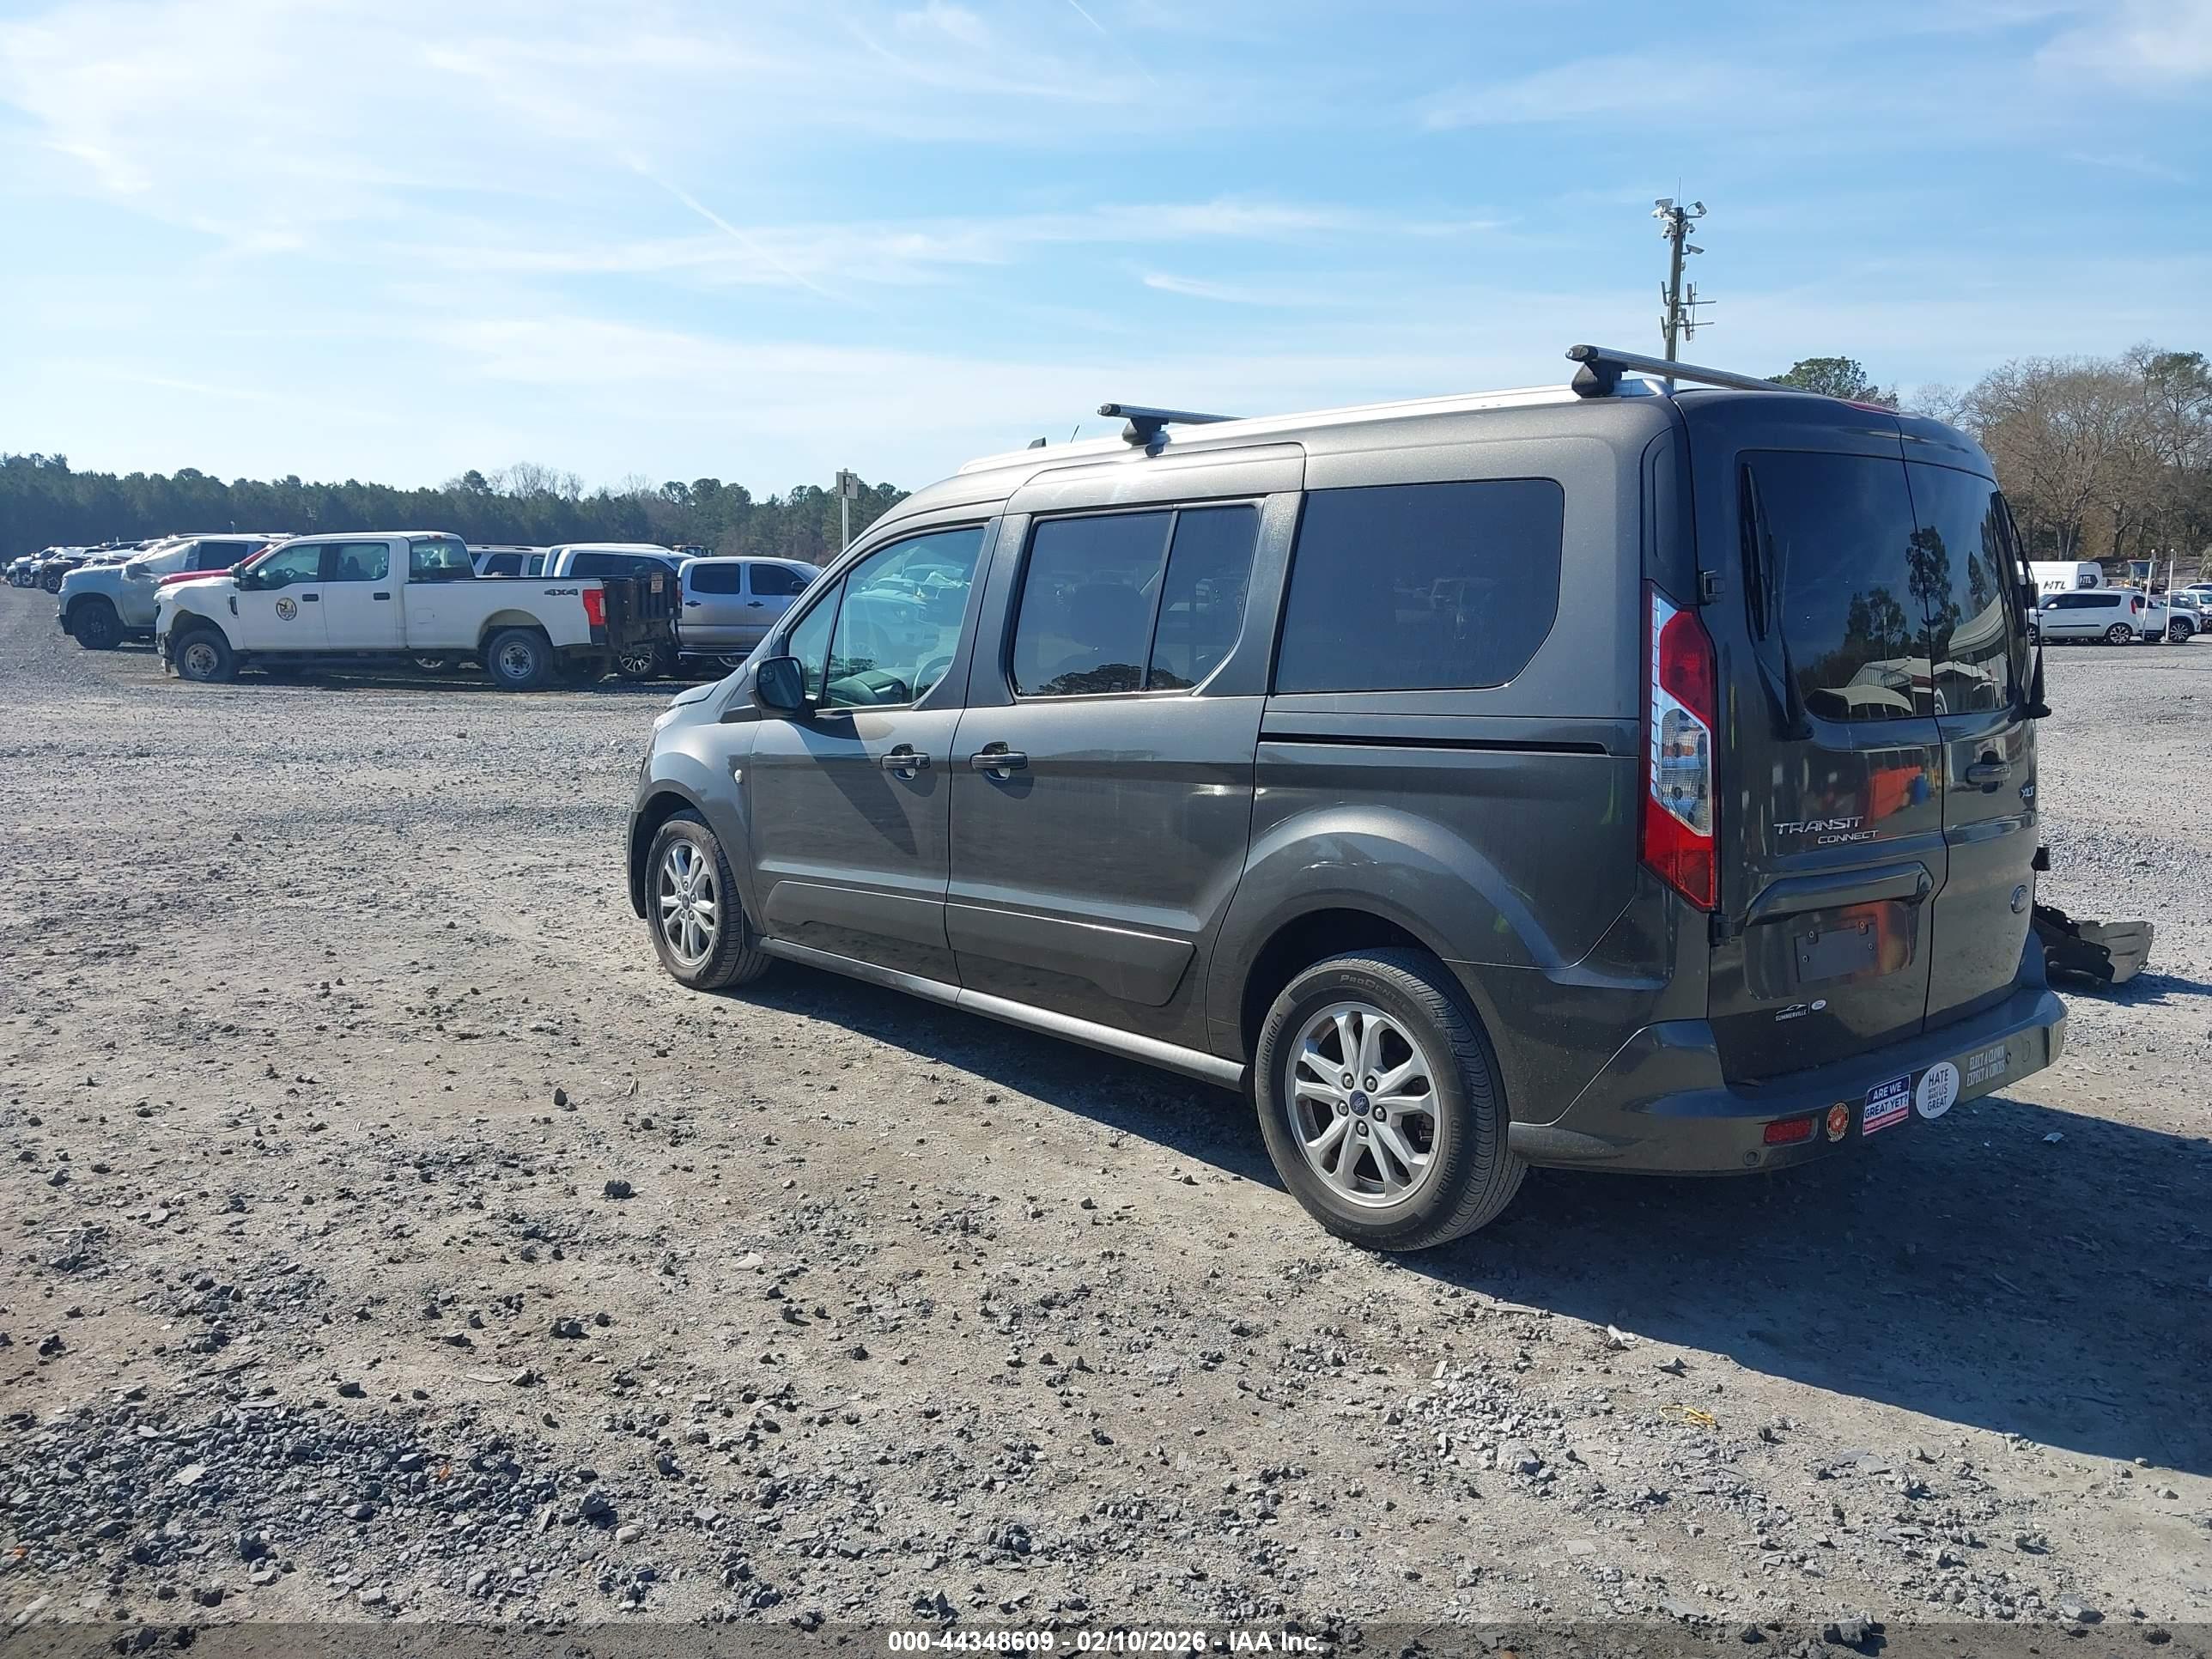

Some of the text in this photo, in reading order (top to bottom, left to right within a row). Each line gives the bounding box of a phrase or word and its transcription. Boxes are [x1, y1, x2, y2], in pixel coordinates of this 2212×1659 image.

[842, 476, 853, 495] F
[2021, 786, 2034, 798] XLT
[1773, 816, 1863, 835] TRANSIT
[1817, 830, 1879, 844] CONNECT
[1928, 1068, 1949, 1088] HATE
[1872, 1081, 1903, 1102] ARE WE
[1938, 1083, 1948, 1096] US
[1864, 1093, 1908, 1119] GREAT YET?
[1927, 1095, 1948, 1111] GREAT
